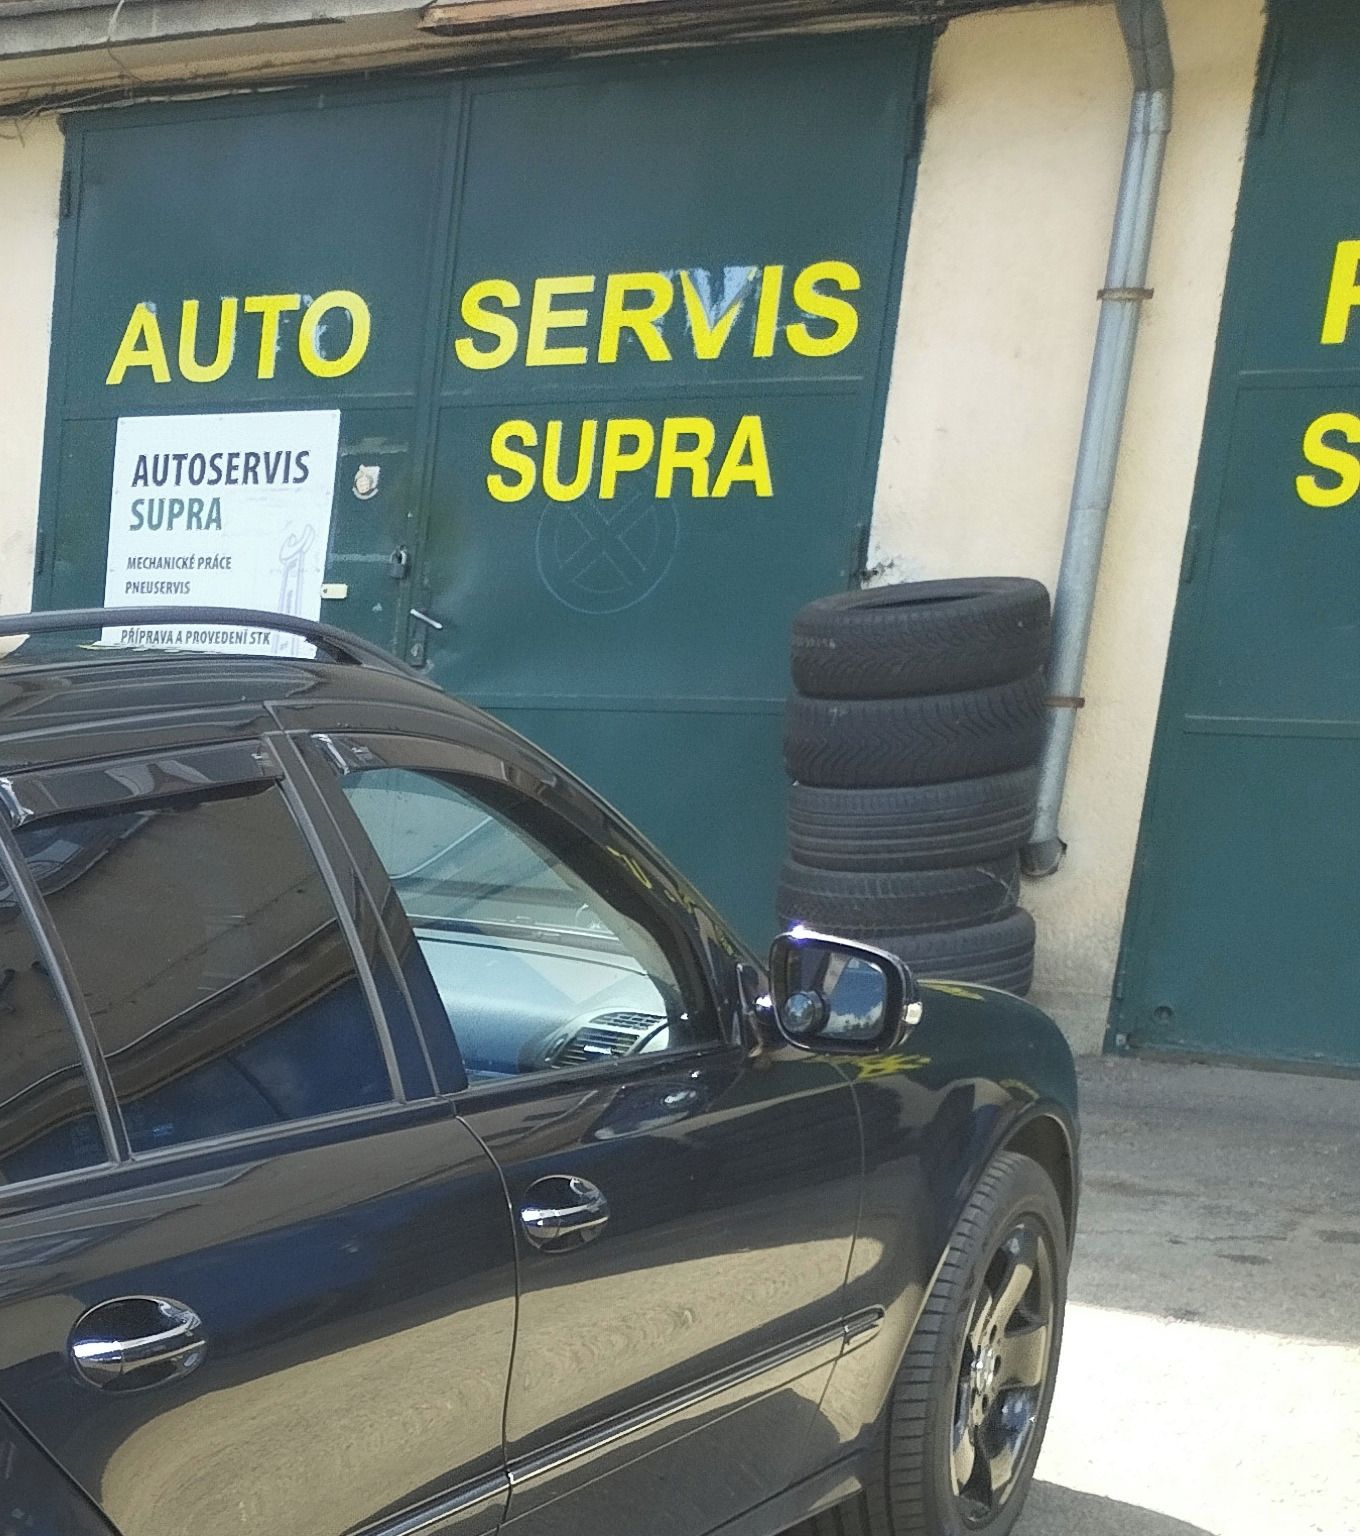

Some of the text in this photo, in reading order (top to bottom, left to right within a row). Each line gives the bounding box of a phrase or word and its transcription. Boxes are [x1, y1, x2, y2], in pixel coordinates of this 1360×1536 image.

[106, 260, 861, 386] AUTO SERVIS
[131, 450, 311, 488] AUTOSERVIS
[486, 414, 774, 503] SUPRA
[129, 497, 222, 531] SUPRA
[126, 553, 232, 570] MECHANICKÉ PRÁCE
[124, 581, 191, 595] PNEUSERVIS
[120, 629, 271, 646] PŘÍPRAVA A PROVEDENÍ STK
